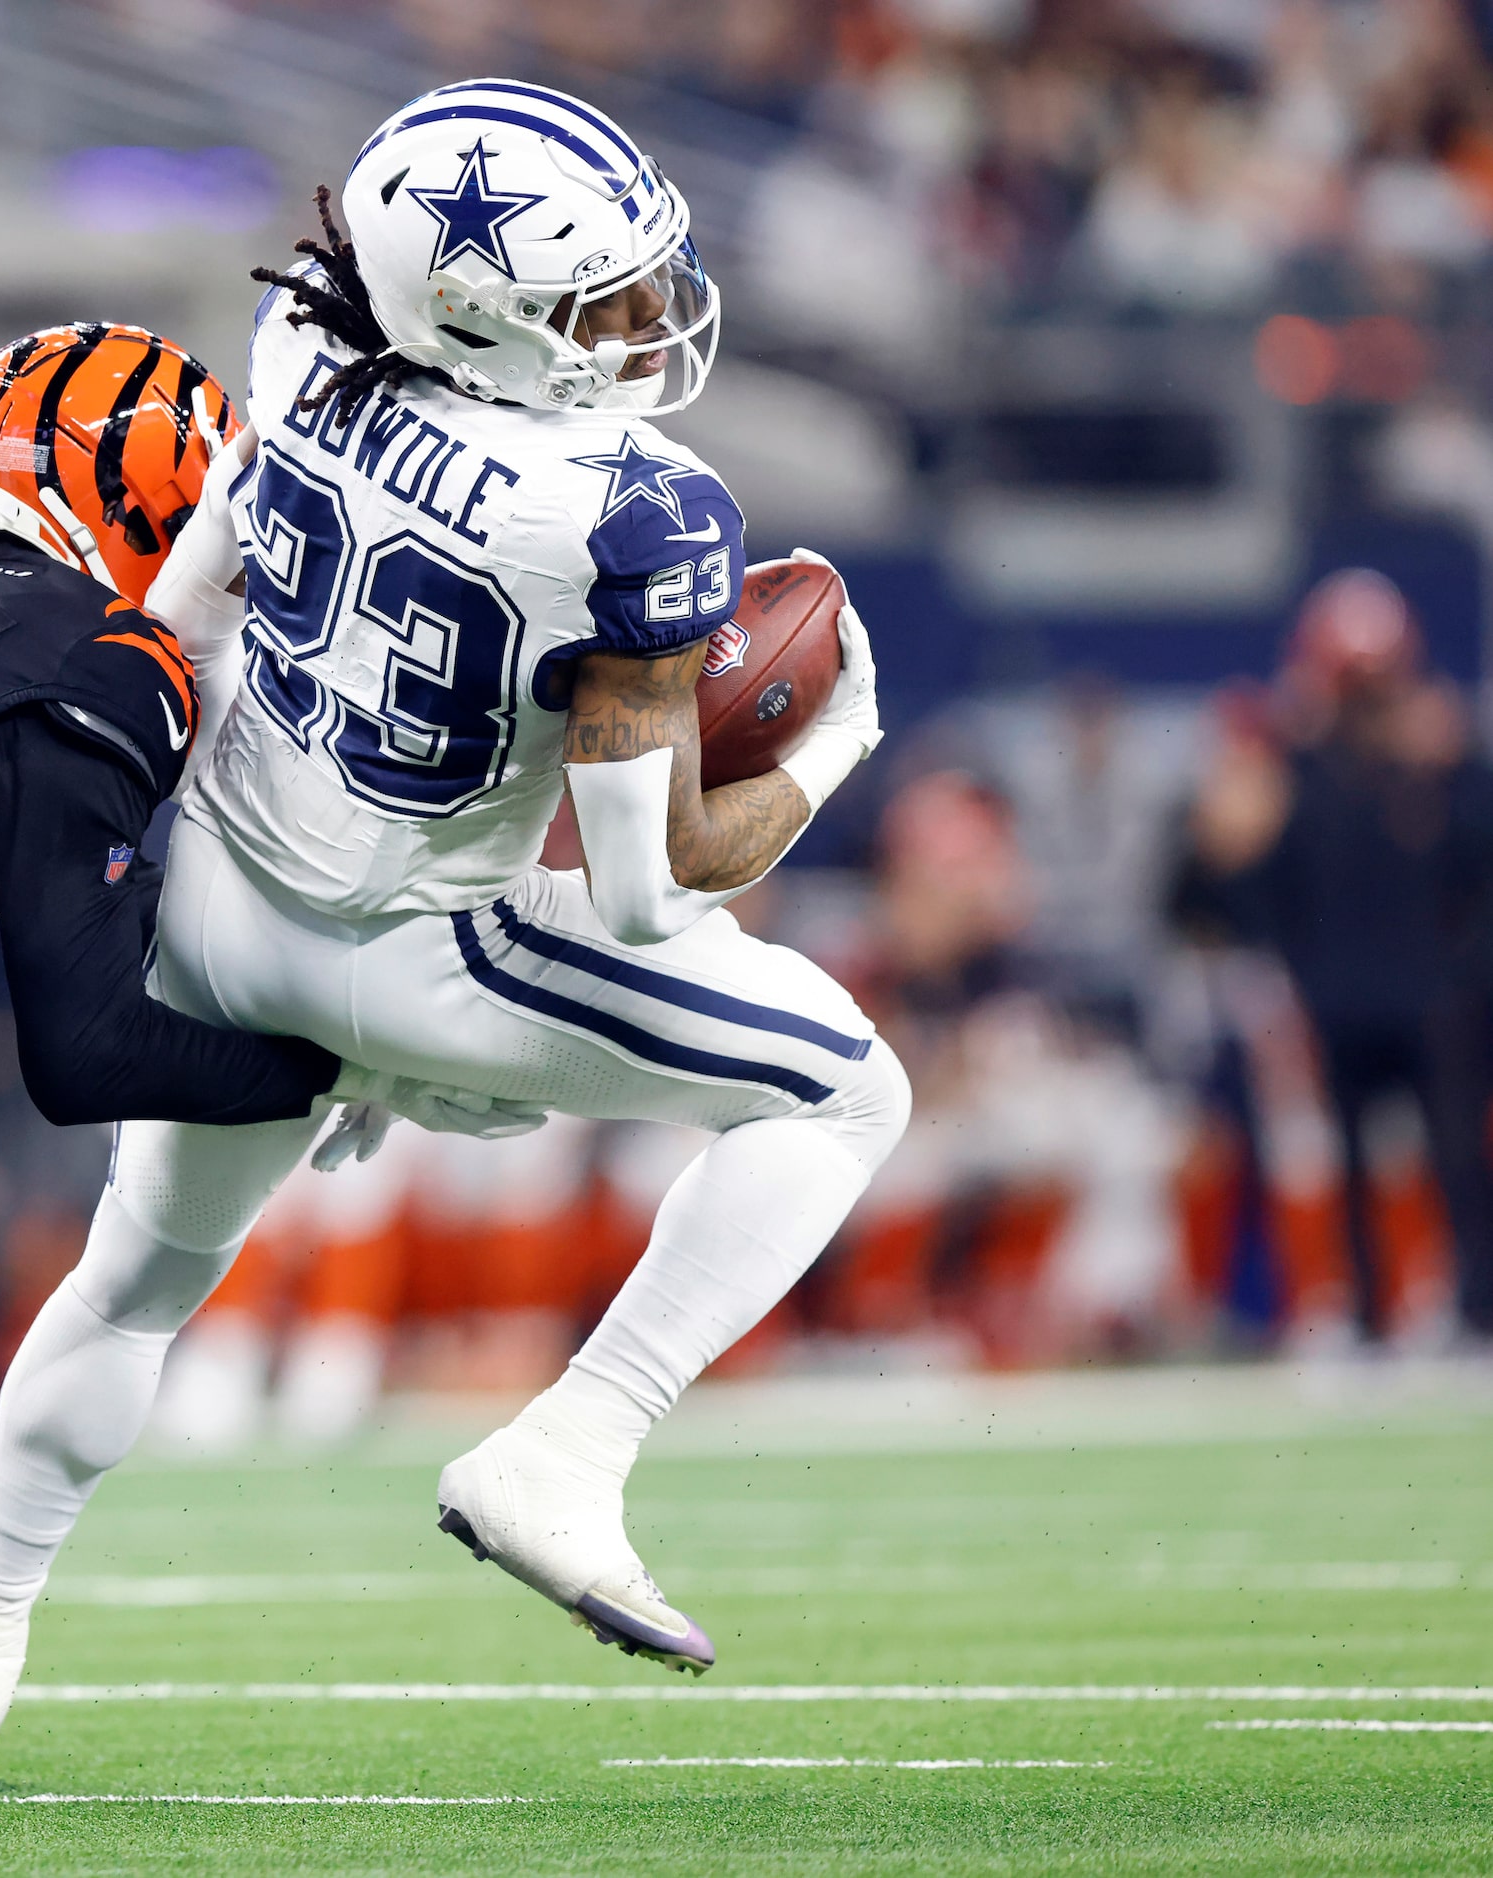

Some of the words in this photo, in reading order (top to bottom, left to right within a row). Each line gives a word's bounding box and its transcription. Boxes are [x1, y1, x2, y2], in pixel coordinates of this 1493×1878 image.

[577, 259, 618, 282] OAKLEY
[283, 351, 520, 547] DOWDLE
[644, 545, 731, 622] 23
[238, 436, 526, 819] 23
[705, 627, 742, 670] NFL
[768, 694, 787, 717] 149
